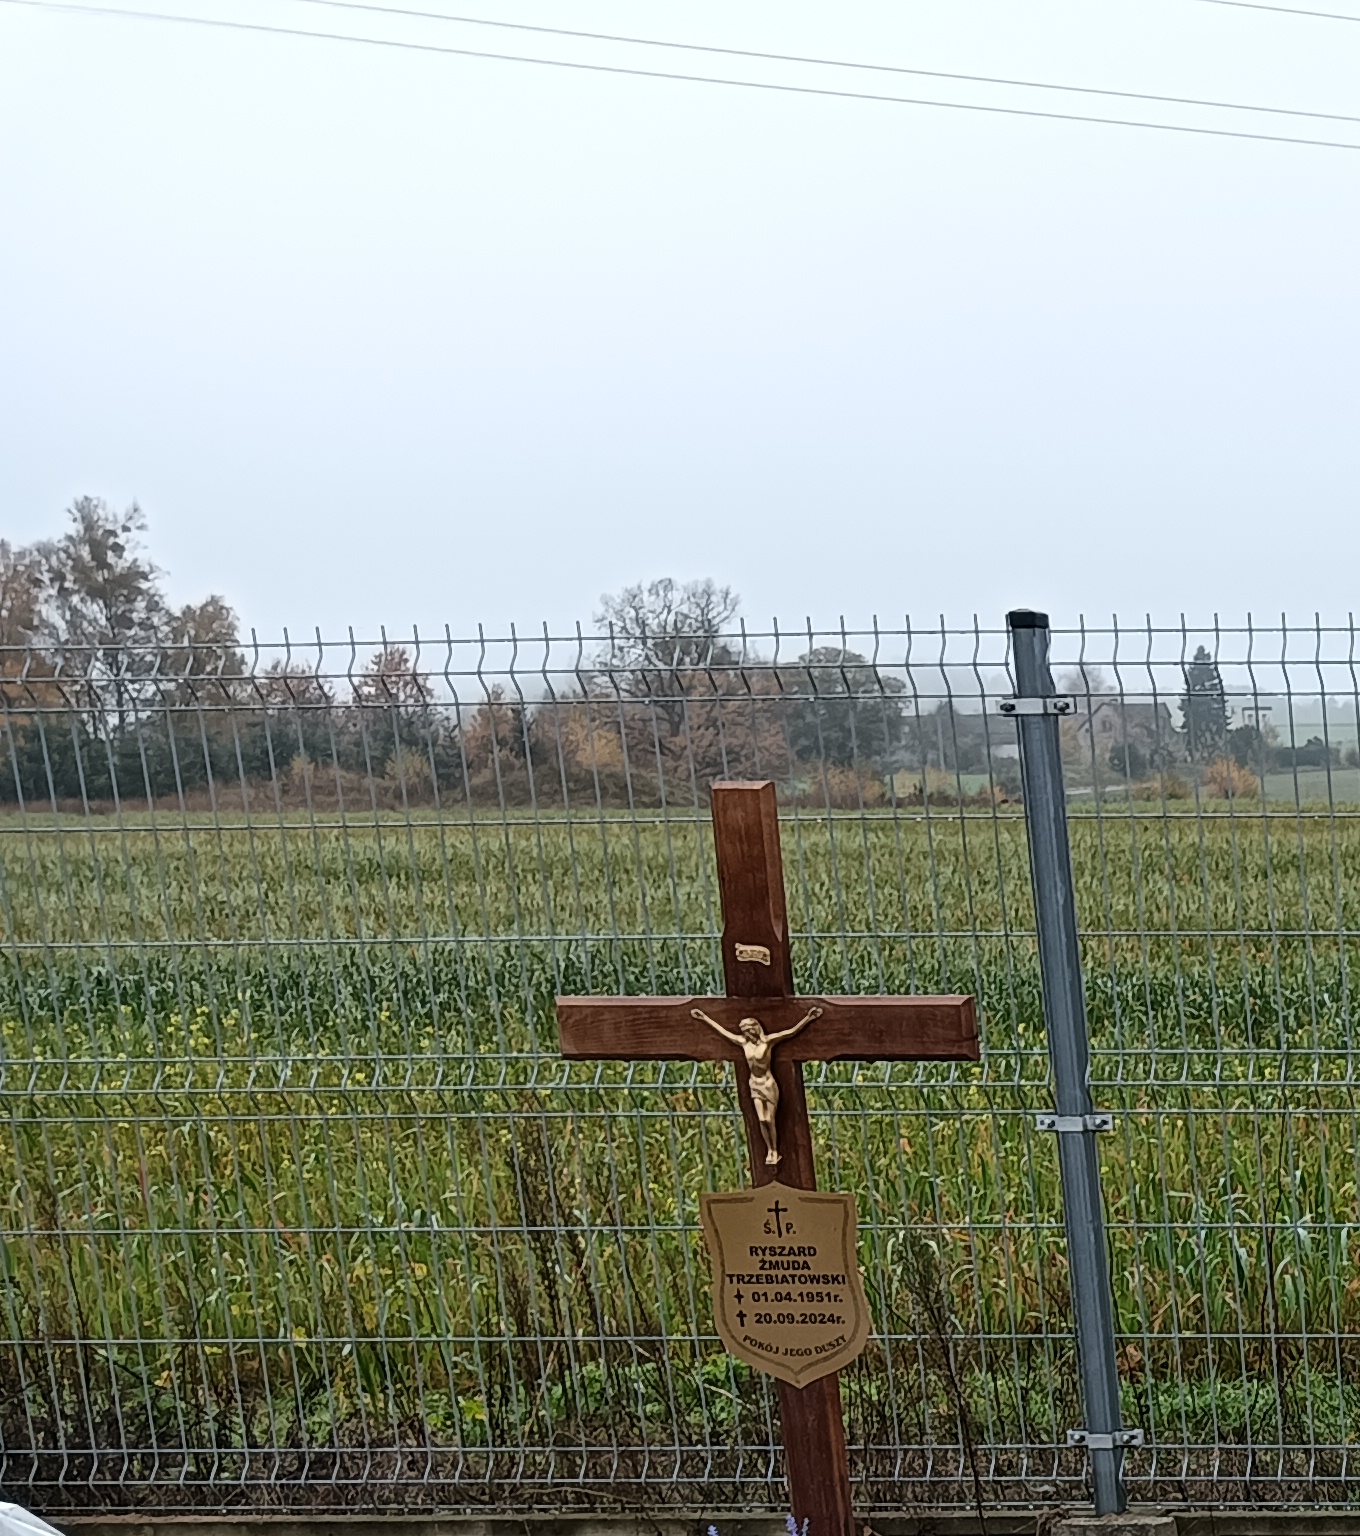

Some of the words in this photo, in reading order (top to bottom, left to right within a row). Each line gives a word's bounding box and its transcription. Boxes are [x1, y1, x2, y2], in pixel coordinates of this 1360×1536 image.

[785, 1222, 797, 1235] P.
[749, 1246, 817, 1257] RYSZARD
[759, 1258, 811, 1270] ŻMUDA
[726, 1274, 846, 1285] TRZEBIATOWSKI
[751, 1291, 843, 1303] 01.04.1951r.
[754, 1313, 846, 1325] 20.09.2024r.
[742, 1334, 779, 1355] POKÓJ
[782, 1347, 813, 1357] JEGO
[815, 1334, 847, 1355] DUSZY
